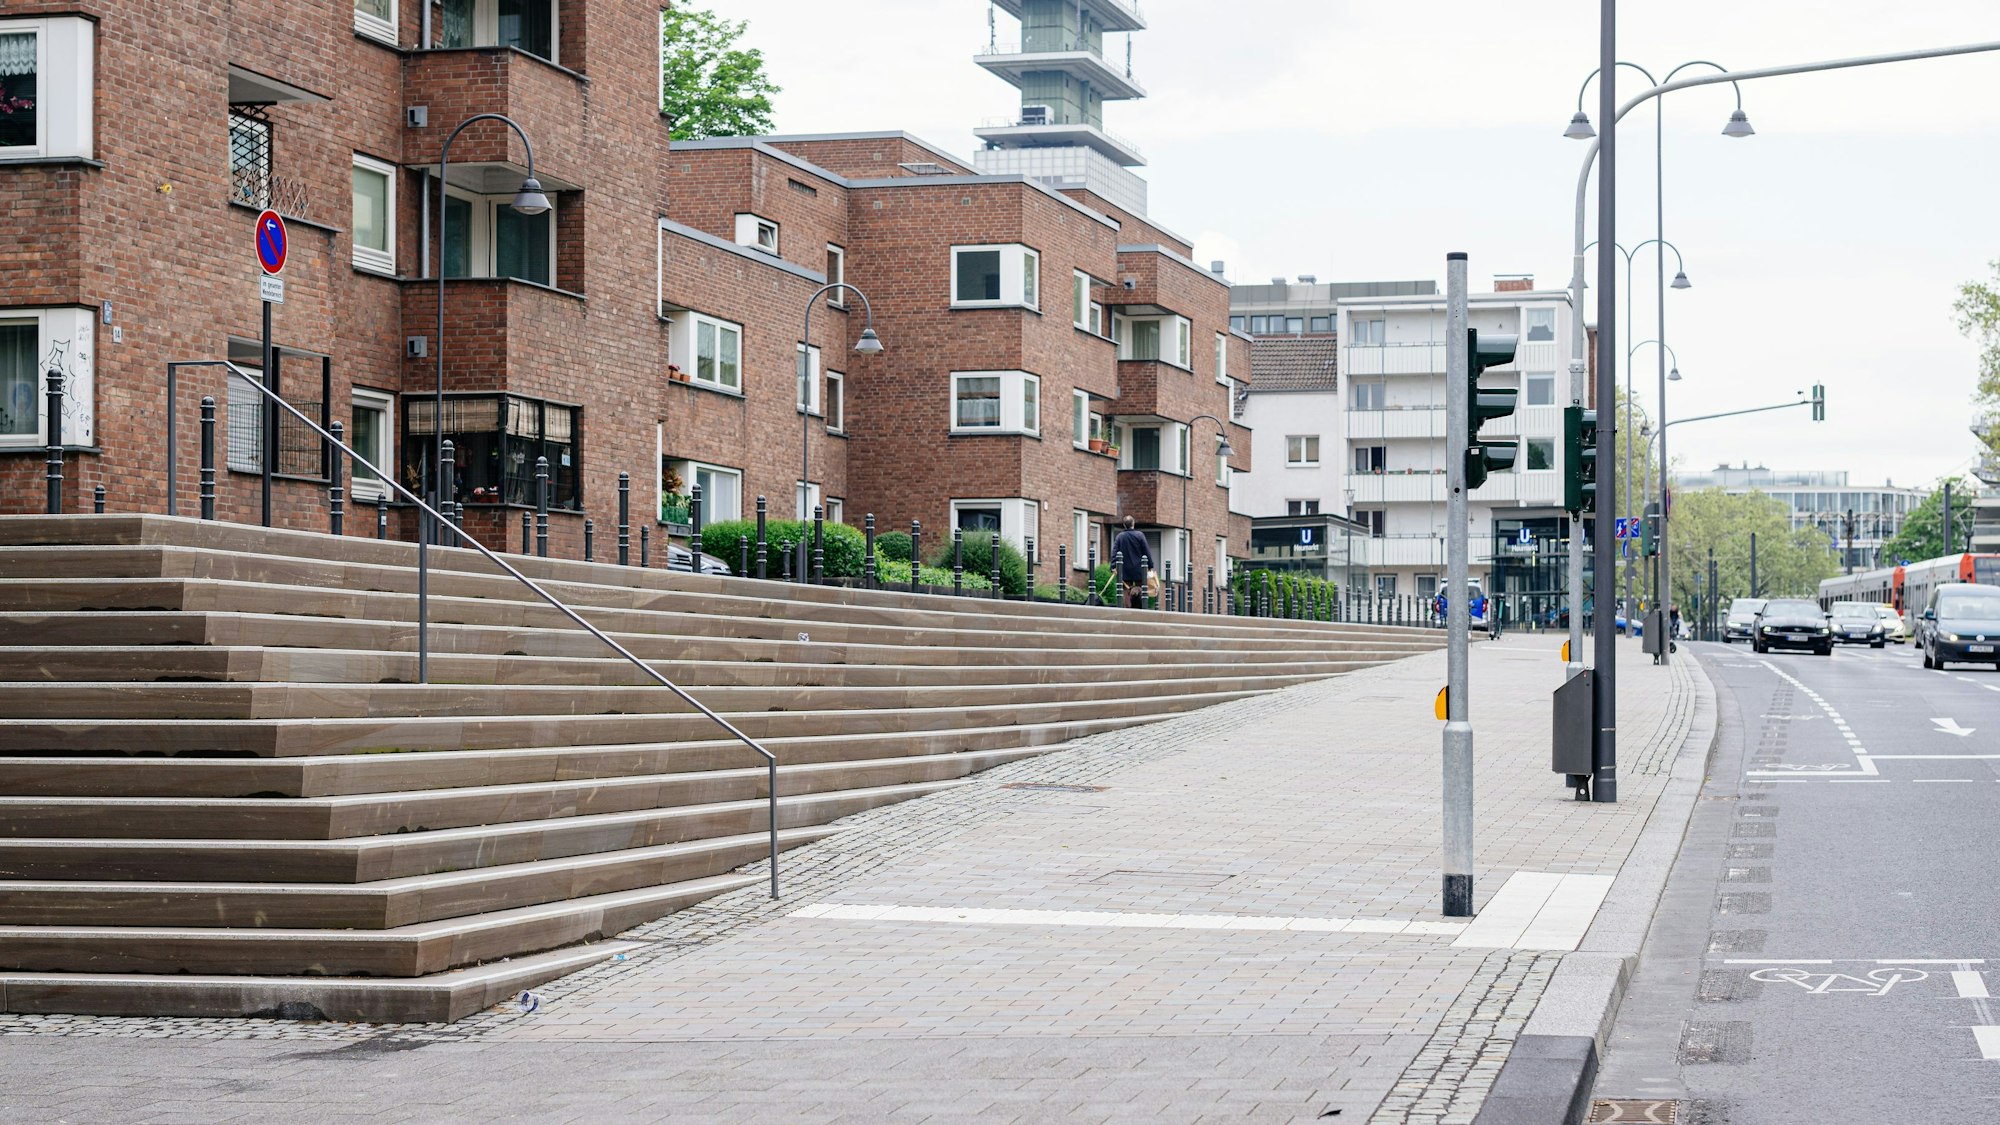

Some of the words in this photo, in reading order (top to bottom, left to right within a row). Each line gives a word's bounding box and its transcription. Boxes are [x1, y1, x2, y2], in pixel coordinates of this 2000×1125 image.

[1302, 529, 1312, 544] U
[1520, 528, 1530, 543] U
[1293, 543, 1319, 552] Heumarkt
[1511, 543, 1539, 552] Heumarkt
